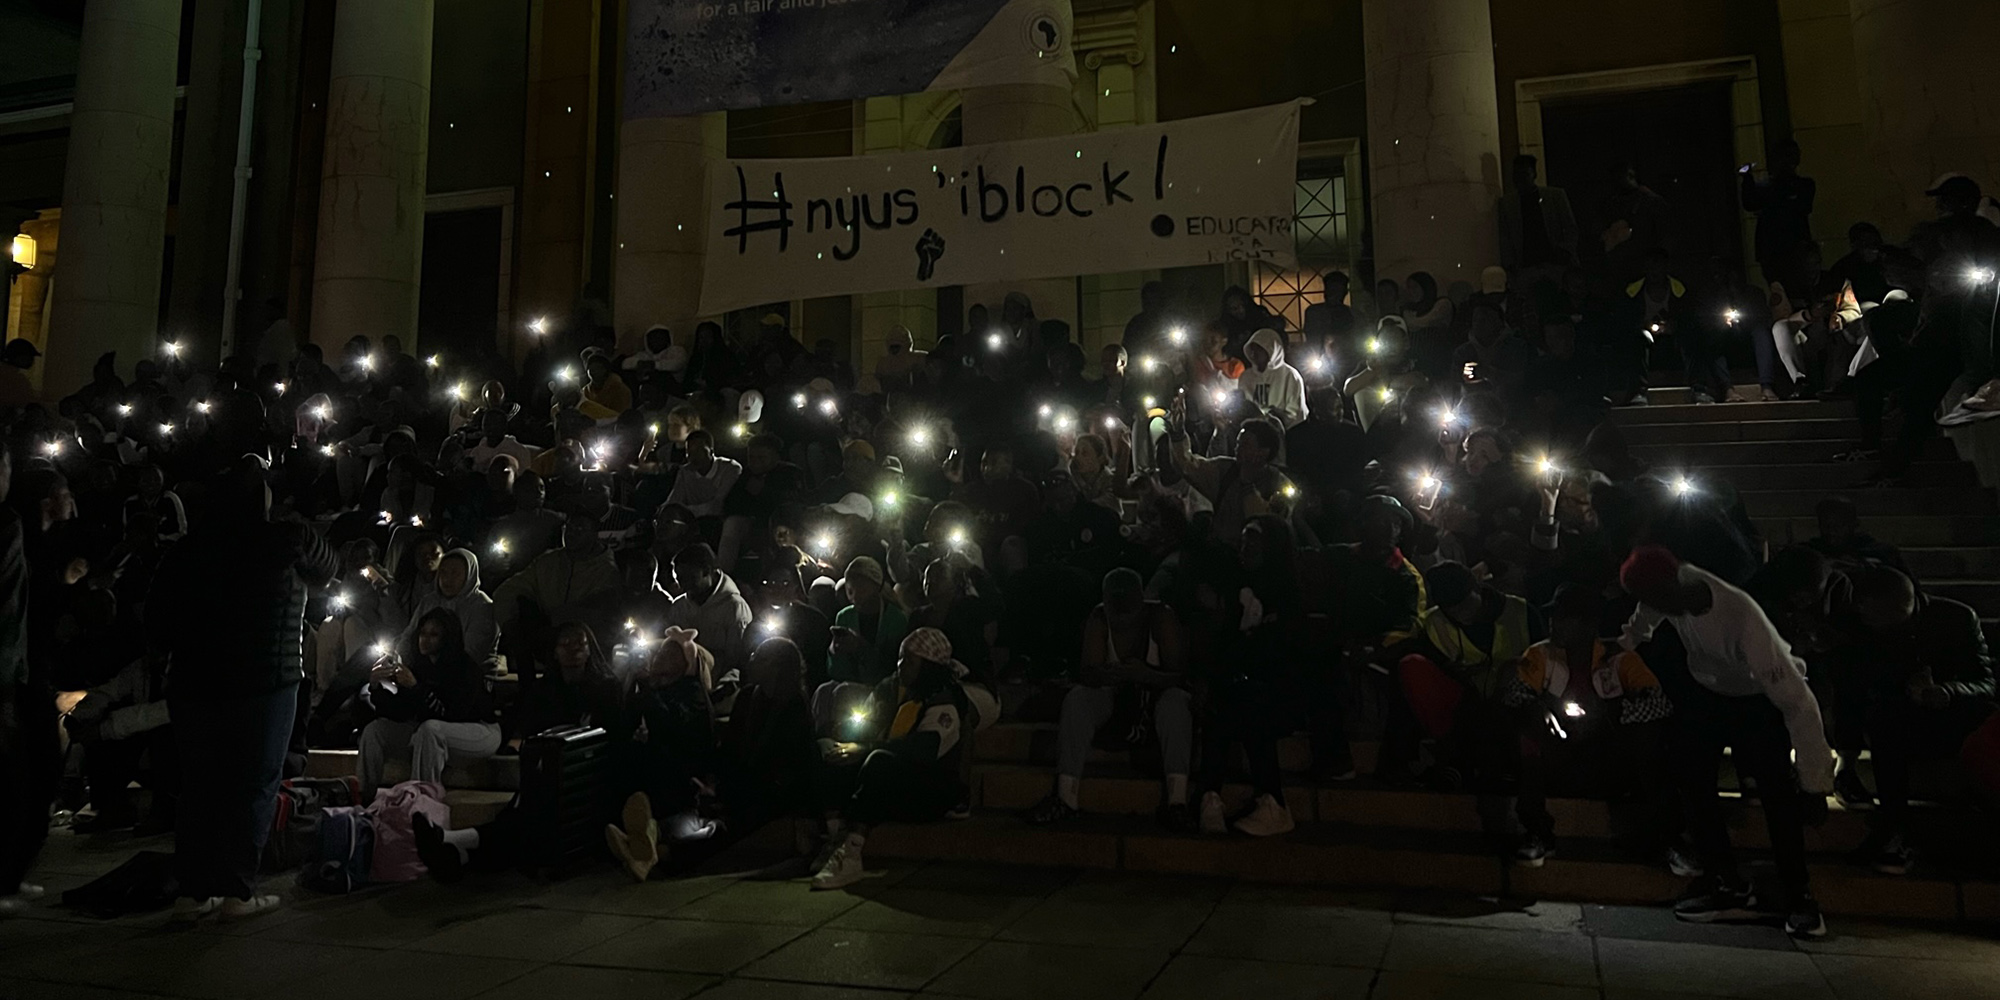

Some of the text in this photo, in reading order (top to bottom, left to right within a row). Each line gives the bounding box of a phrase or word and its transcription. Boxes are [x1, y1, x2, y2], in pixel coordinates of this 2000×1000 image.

[697, 2, 721, 19] for
[727, 3, 738, 15] a
[1252, 238, 1263, 249] A
